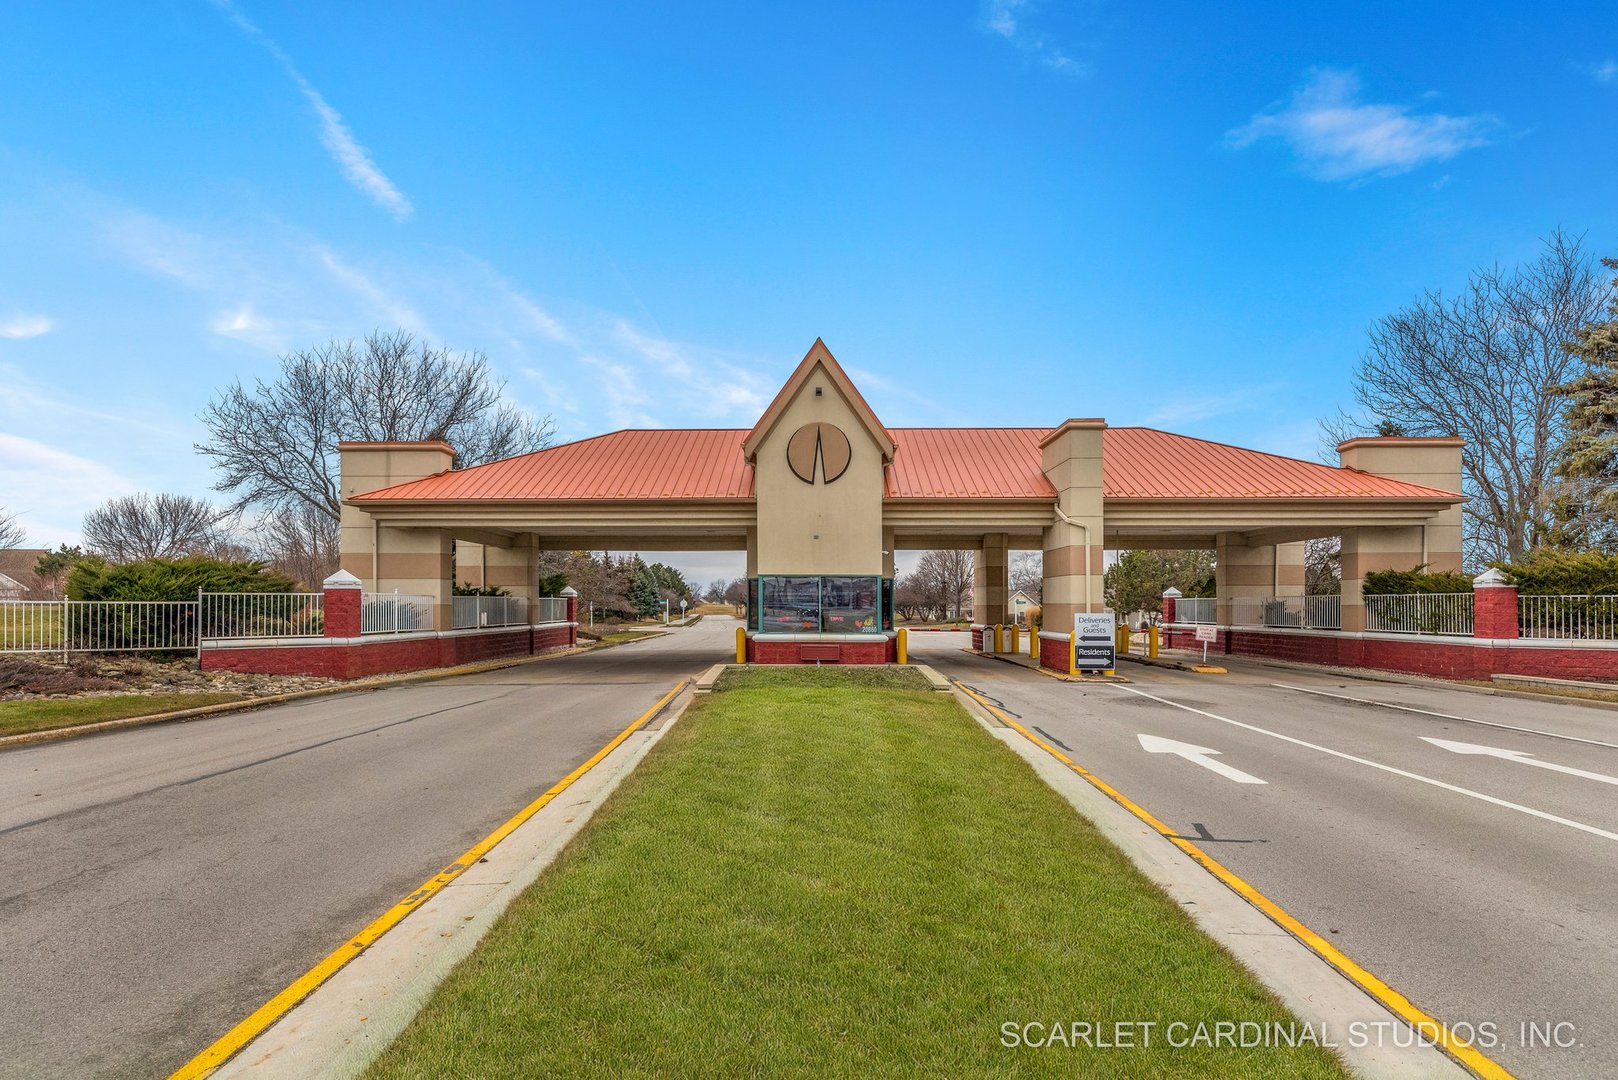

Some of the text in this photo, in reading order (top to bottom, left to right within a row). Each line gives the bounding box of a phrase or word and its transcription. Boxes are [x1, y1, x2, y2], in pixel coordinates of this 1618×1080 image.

[1078, 616, 1111, 624] Deliveries
[1082, 626, 1107, 634] Guests
[1078, 648, 1111, 656] Residents
